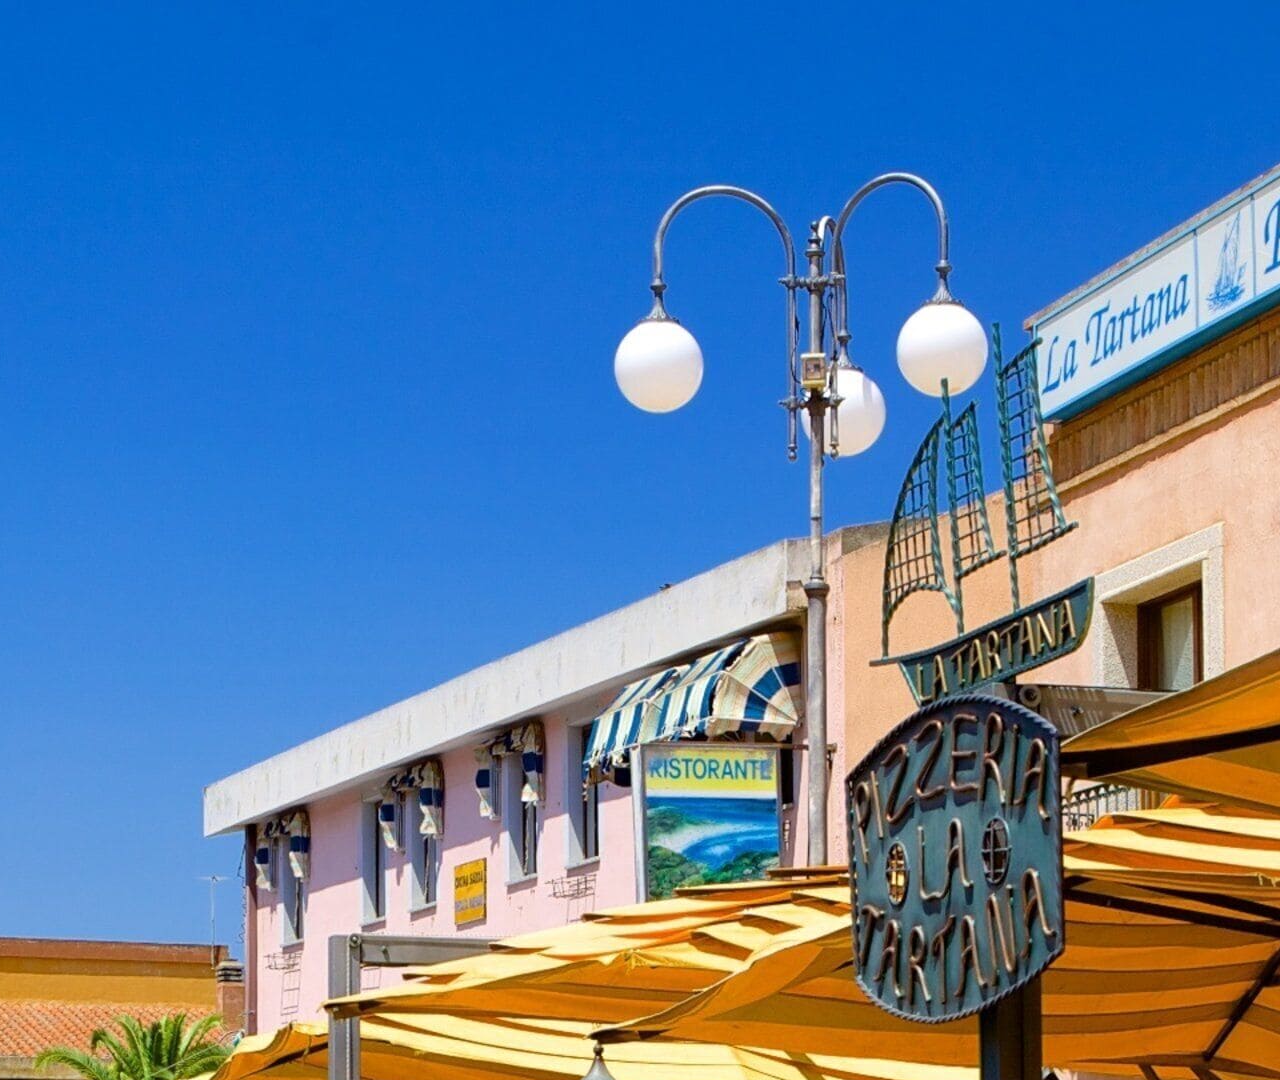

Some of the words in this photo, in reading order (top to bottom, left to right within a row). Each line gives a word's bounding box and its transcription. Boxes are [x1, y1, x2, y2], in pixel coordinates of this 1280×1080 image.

[1042, 335, 1078, 395] La
[1085, 273, 1191, 367] Tartana
[915, 654, 948, 702] LA
[950, 598, 1077, 688] TARTANA
[648, 757, 773, 781] RISTORANTE
[854, 711, 1050, 864] PIZZERIA
[917, 816, 974, 902] LA
[860, 868, 1057, 1005] TARTANA
